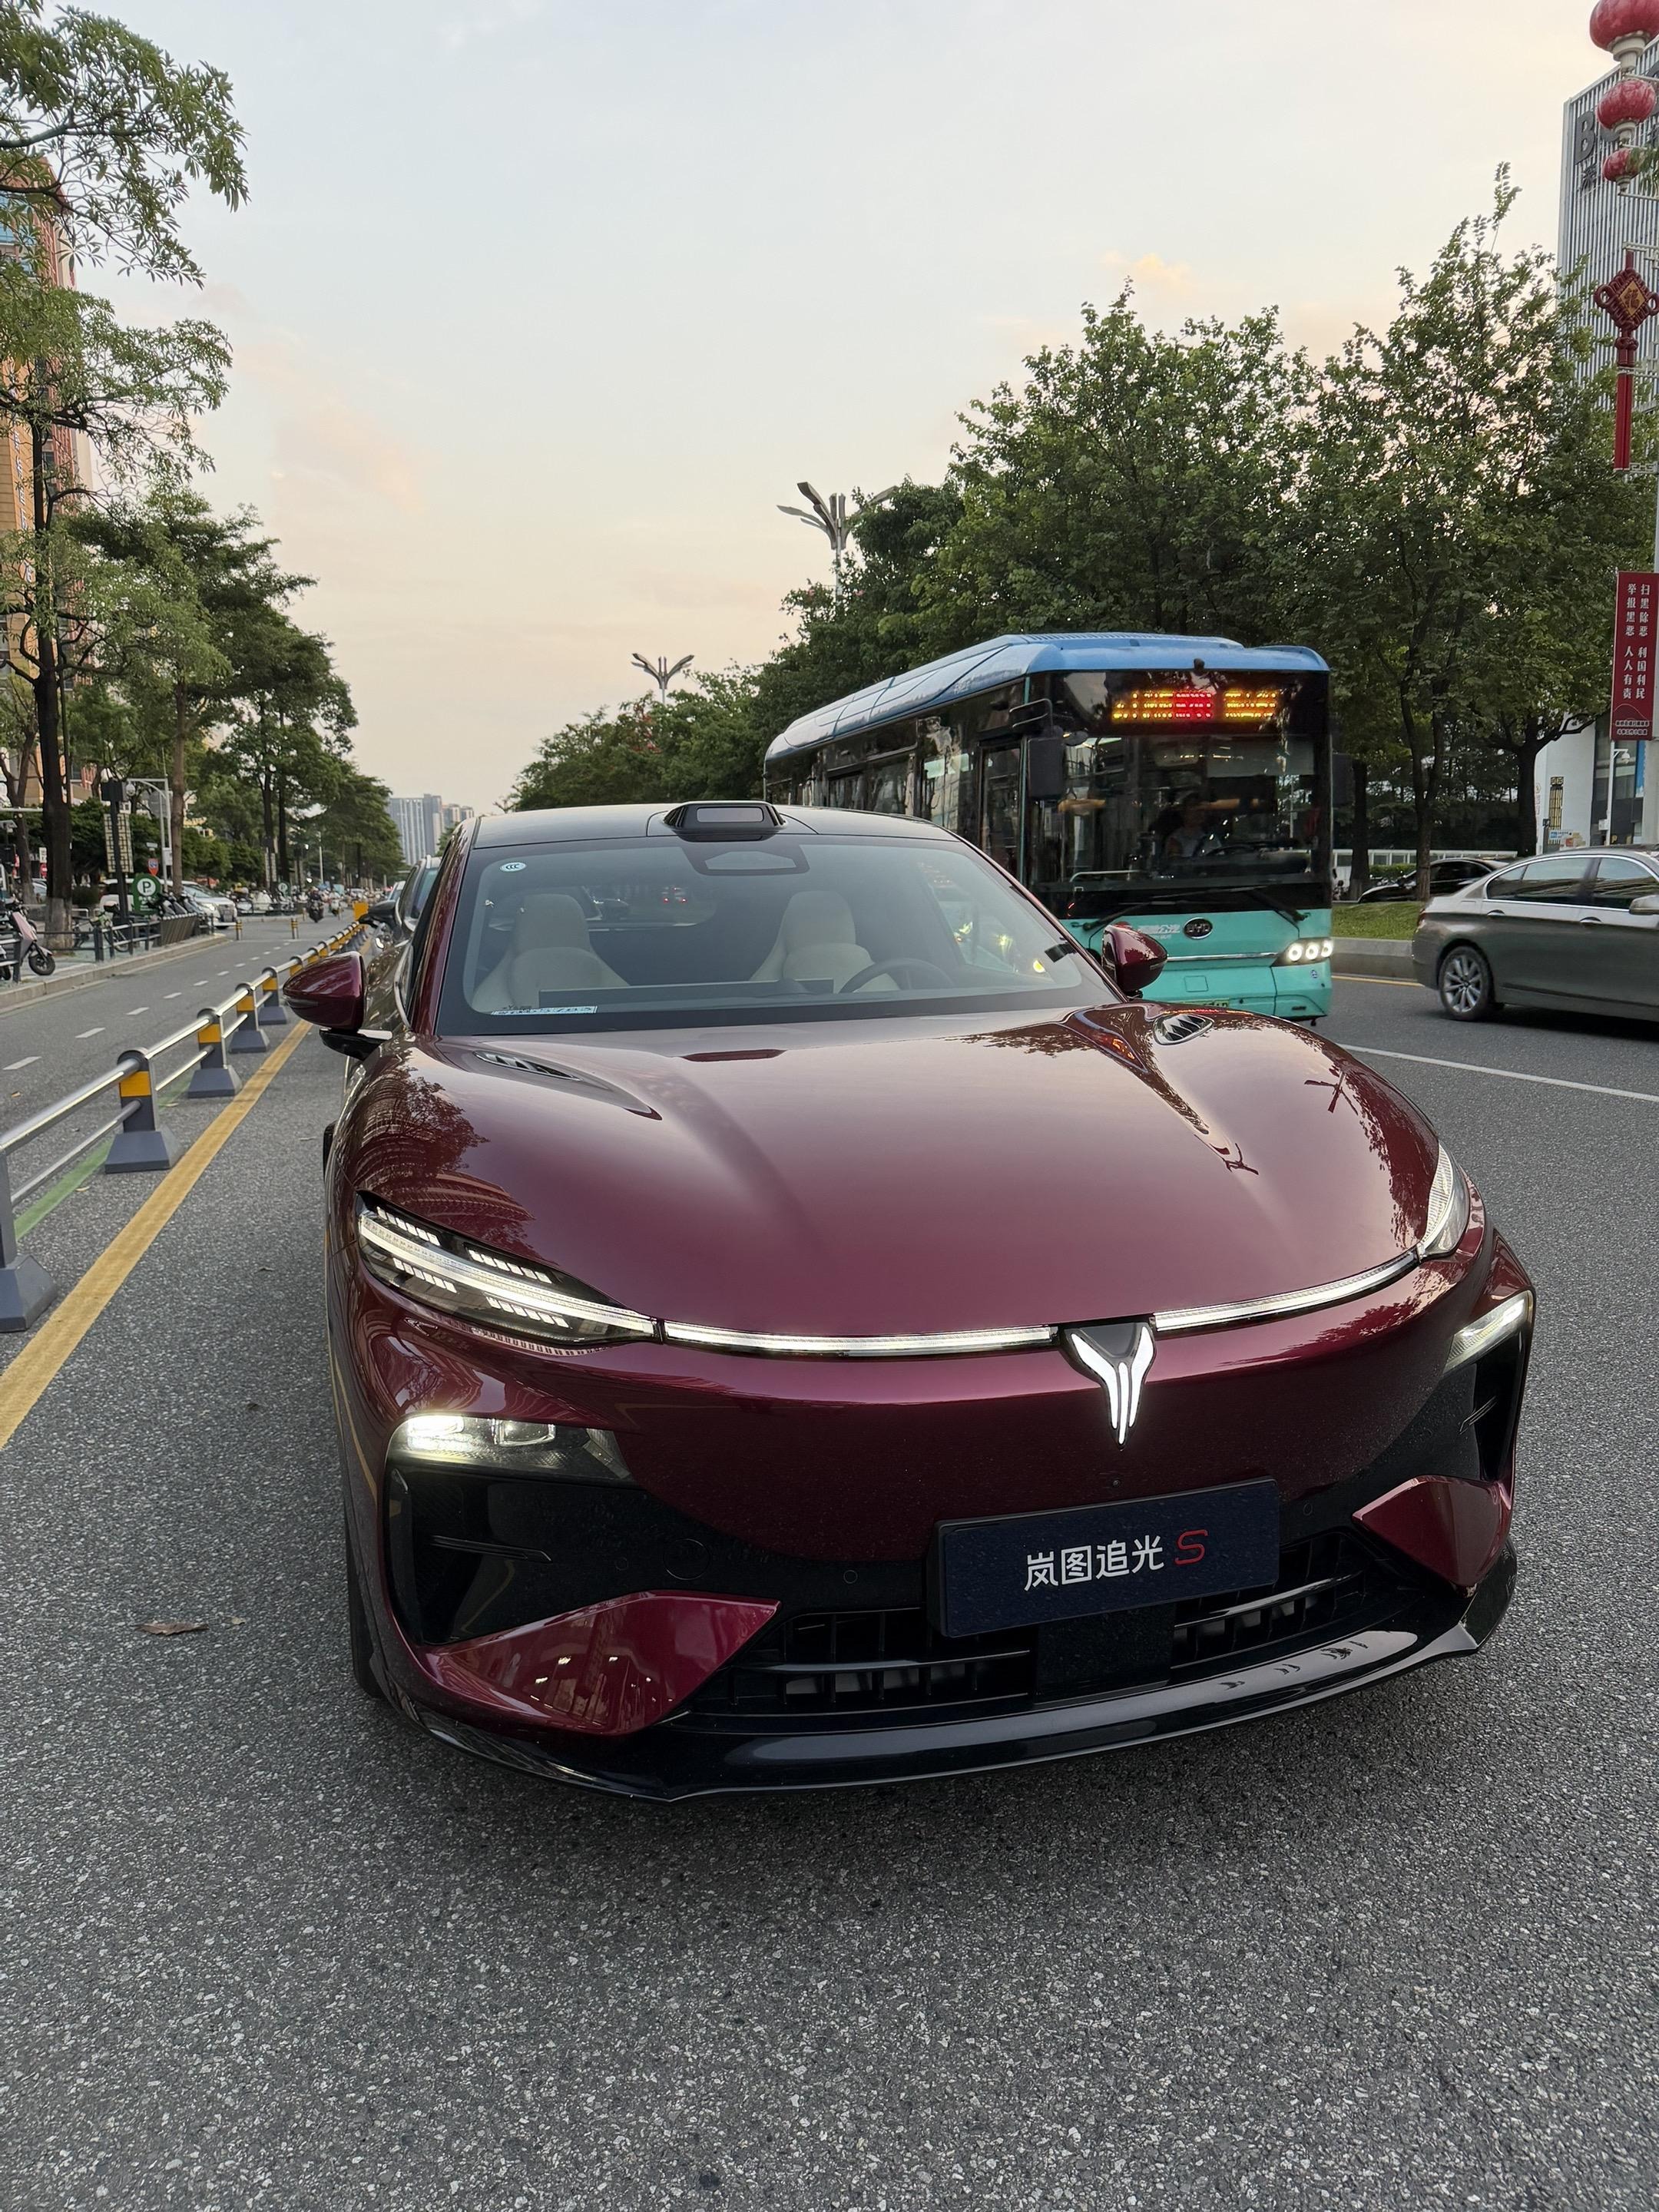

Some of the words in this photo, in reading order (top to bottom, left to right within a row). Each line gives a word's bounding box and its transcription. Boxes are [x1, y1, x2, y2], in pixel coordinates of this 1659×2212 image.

[1625, 584, 1636, 636] 举报黑恶
[1638, 584, 1650, 637] 扫黑除恶
[1623, 646, 1634, 699] 人人有责
[1636, 647, 1647, 699] 利国利民
[142, 881, 151, 893] P
[1024, 1535, 1164, 1591] 岚图追光
[1174, 1529, 1208, 1565] S
